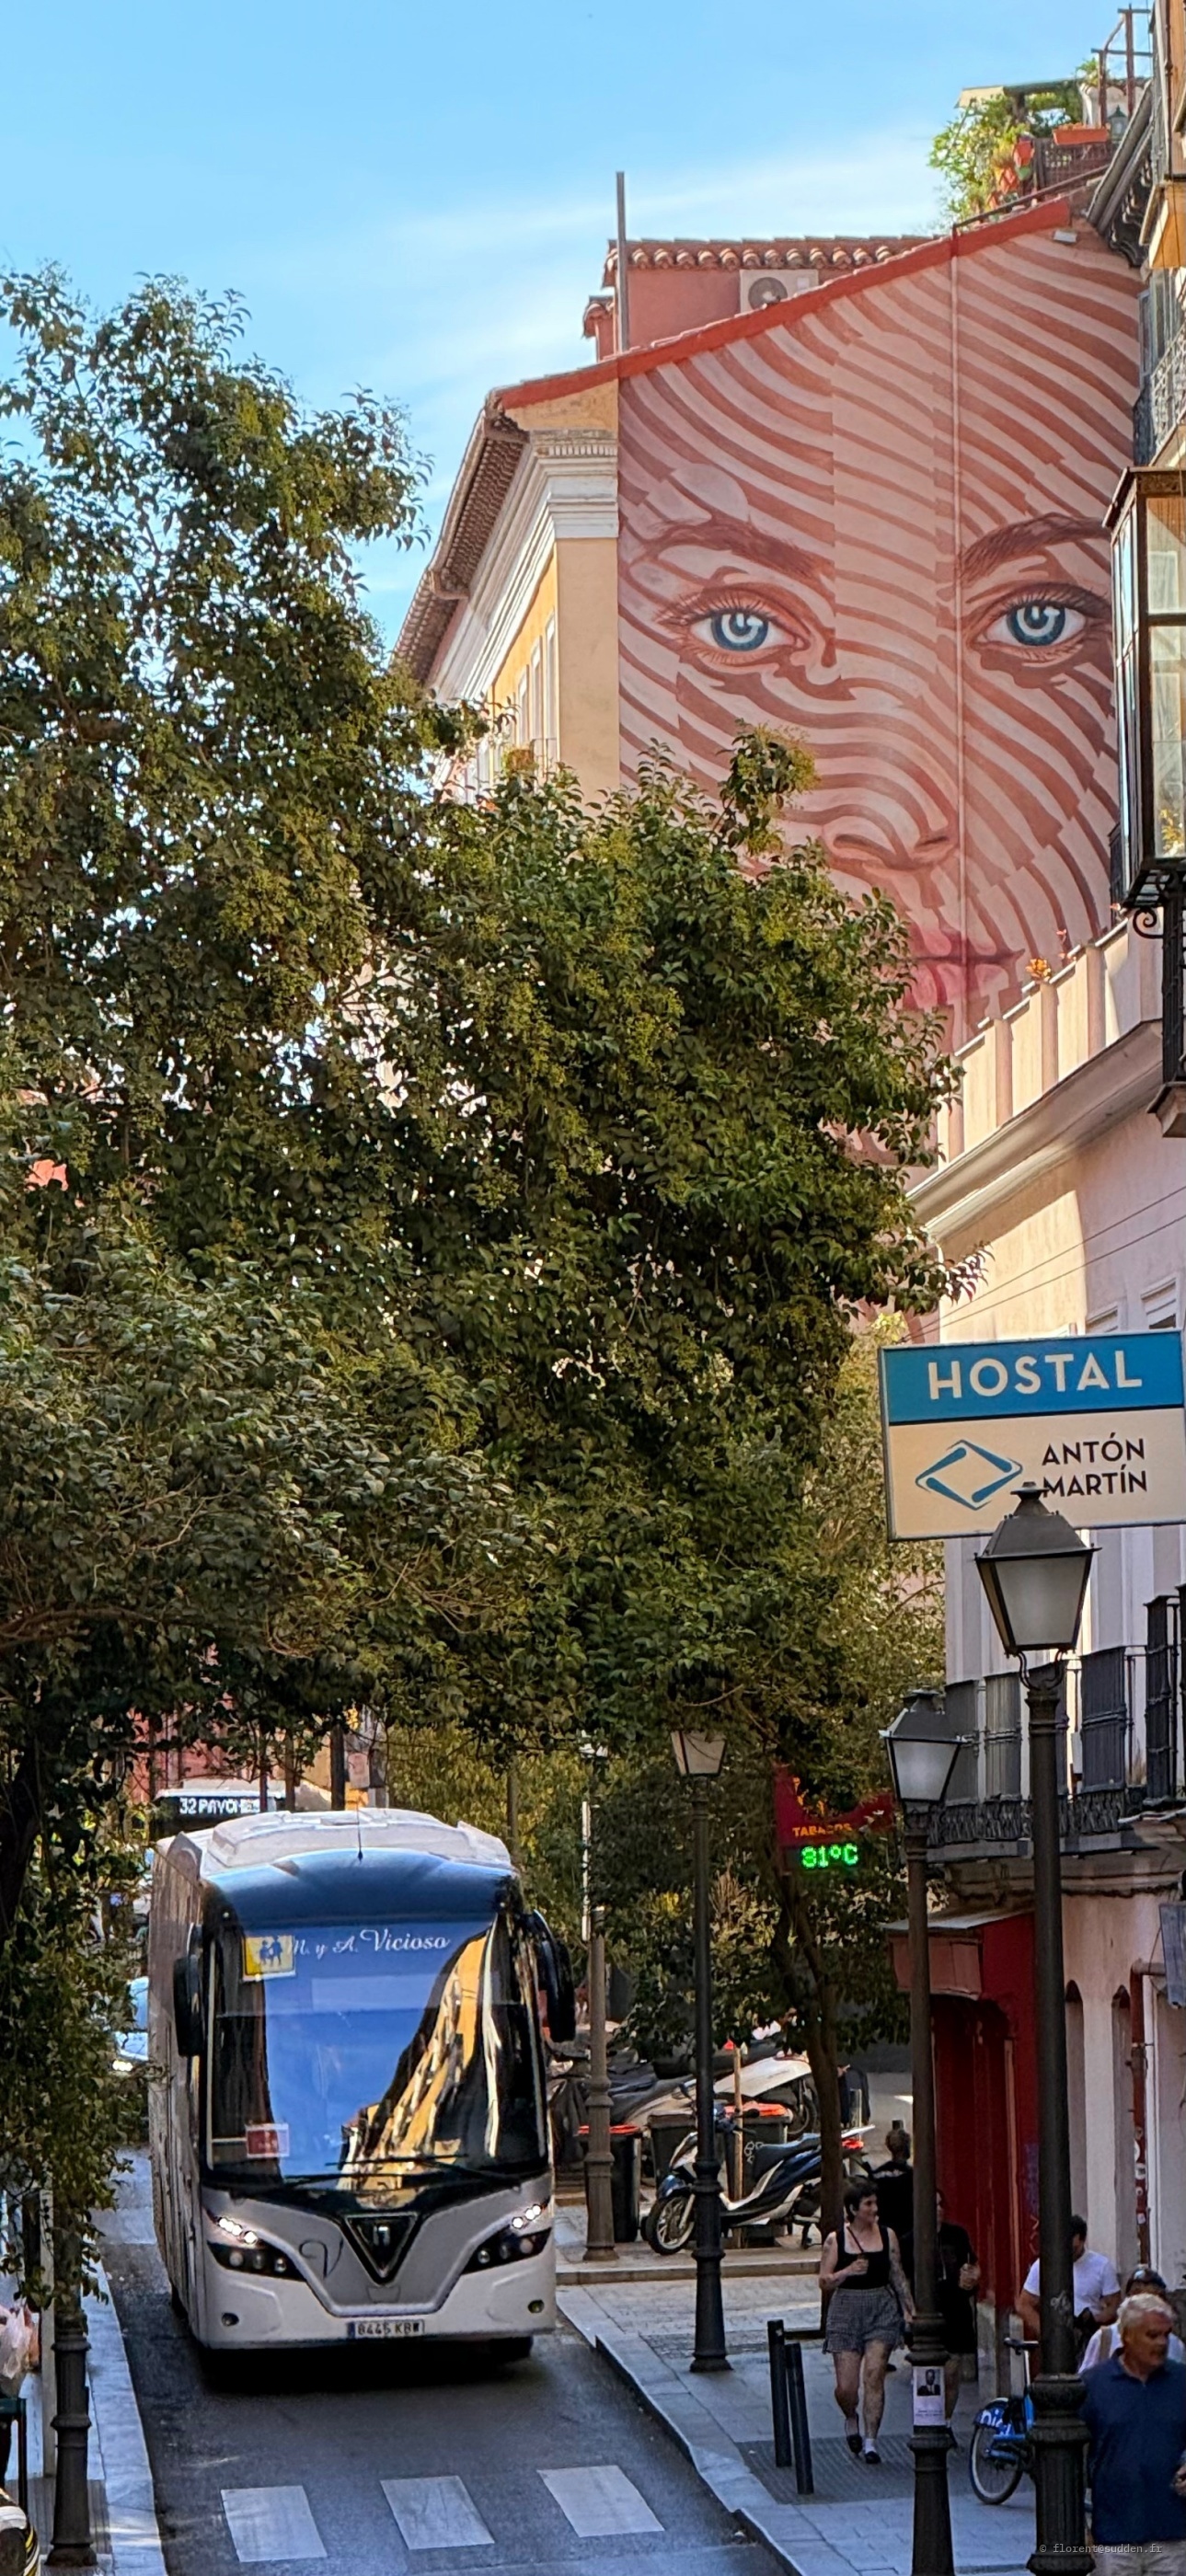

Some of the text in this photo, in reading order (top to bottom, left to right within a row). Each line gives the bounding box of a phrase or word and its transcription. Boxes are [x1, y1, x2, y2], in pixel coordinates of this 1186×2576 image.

[927, 1350, 1143, 1400] HOSTAL
[1042, 1432, 1146, 1466] ANTÓN
[1042, 1464, 1148, 1499] MARTÍN
[178, 1797, 197, 1815] 32
[315, 1944, 328, 1960] y
[360, 1928, 451, 1951] Vicioso
